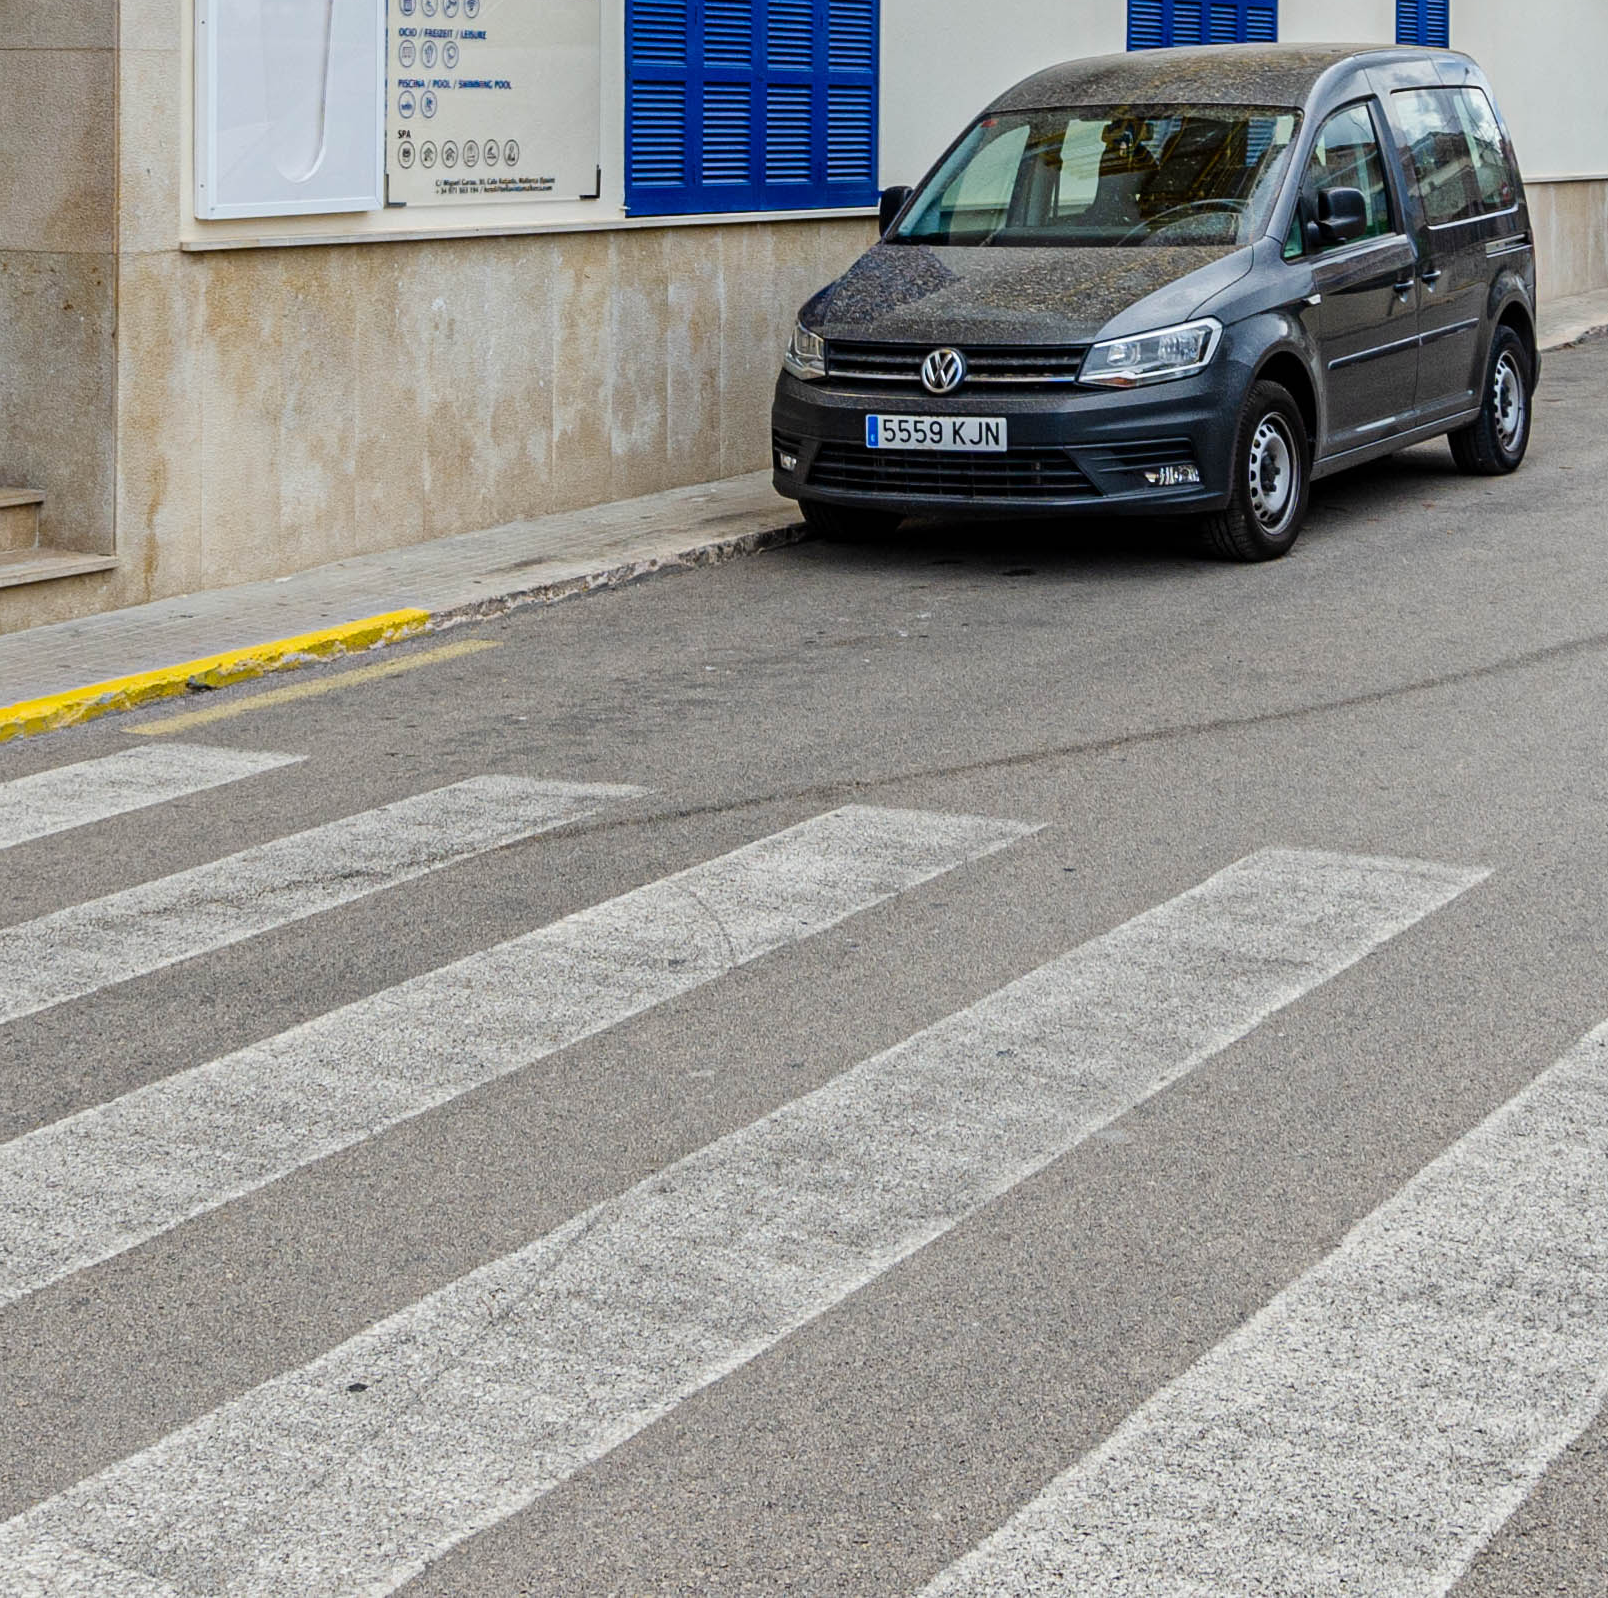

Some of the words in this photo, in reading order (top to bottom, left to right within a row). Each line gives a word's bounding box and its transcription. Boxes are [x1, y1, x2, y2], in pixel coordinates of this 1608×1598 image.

[494, 80, 512, 90] POOL
[398, 130, 411, 139] SPA
[883, 419, 943, 444] 5559
[952, 421, 1000, 446] KJN
